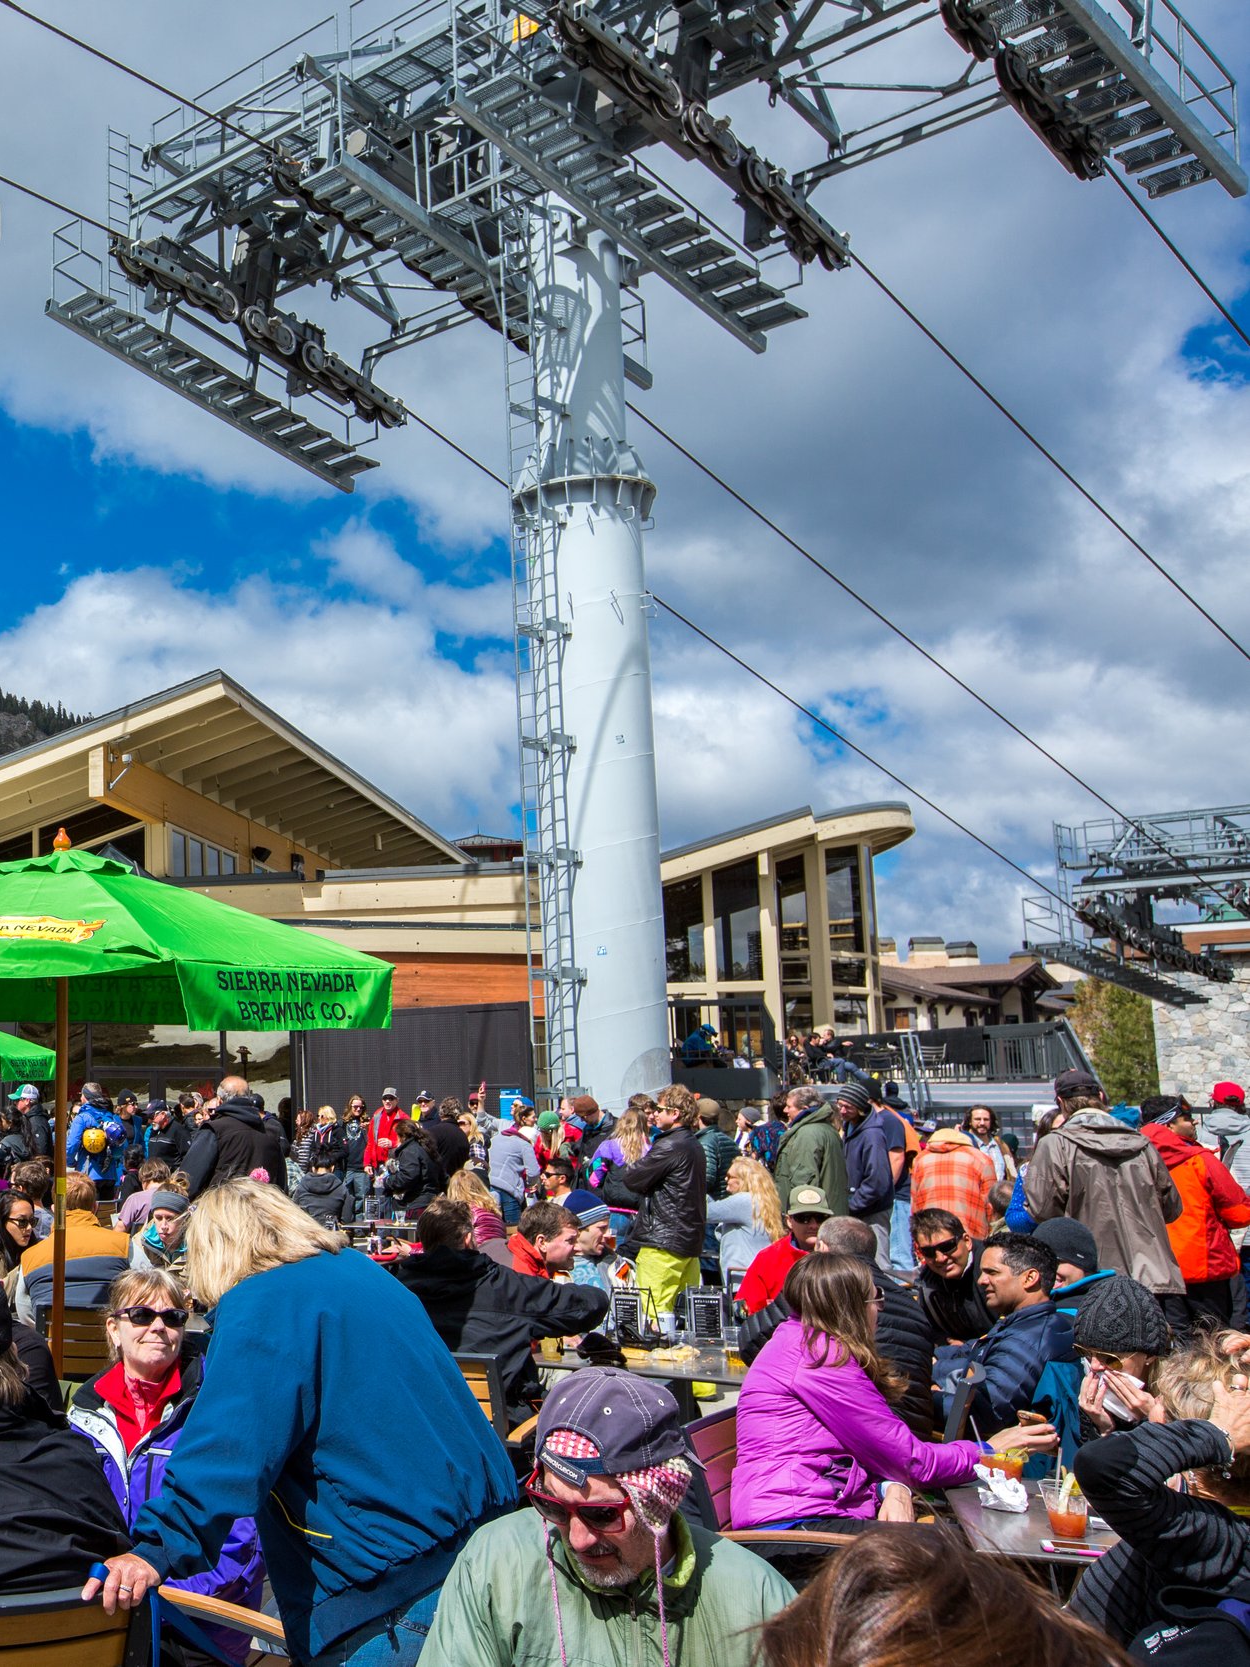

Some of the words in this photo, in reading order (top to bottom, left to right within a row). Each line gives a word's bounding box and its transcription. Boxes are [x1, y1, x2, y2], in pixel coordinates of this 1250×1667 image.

[13, 924, 75, 934] NEVADA
[216, 969, 283, 994] SIERRA
[285, 970, 358, 995] NEVADA
[237, 1000, 314, 1024] BREWING
[320, 1002, 353, 1021] CO.
